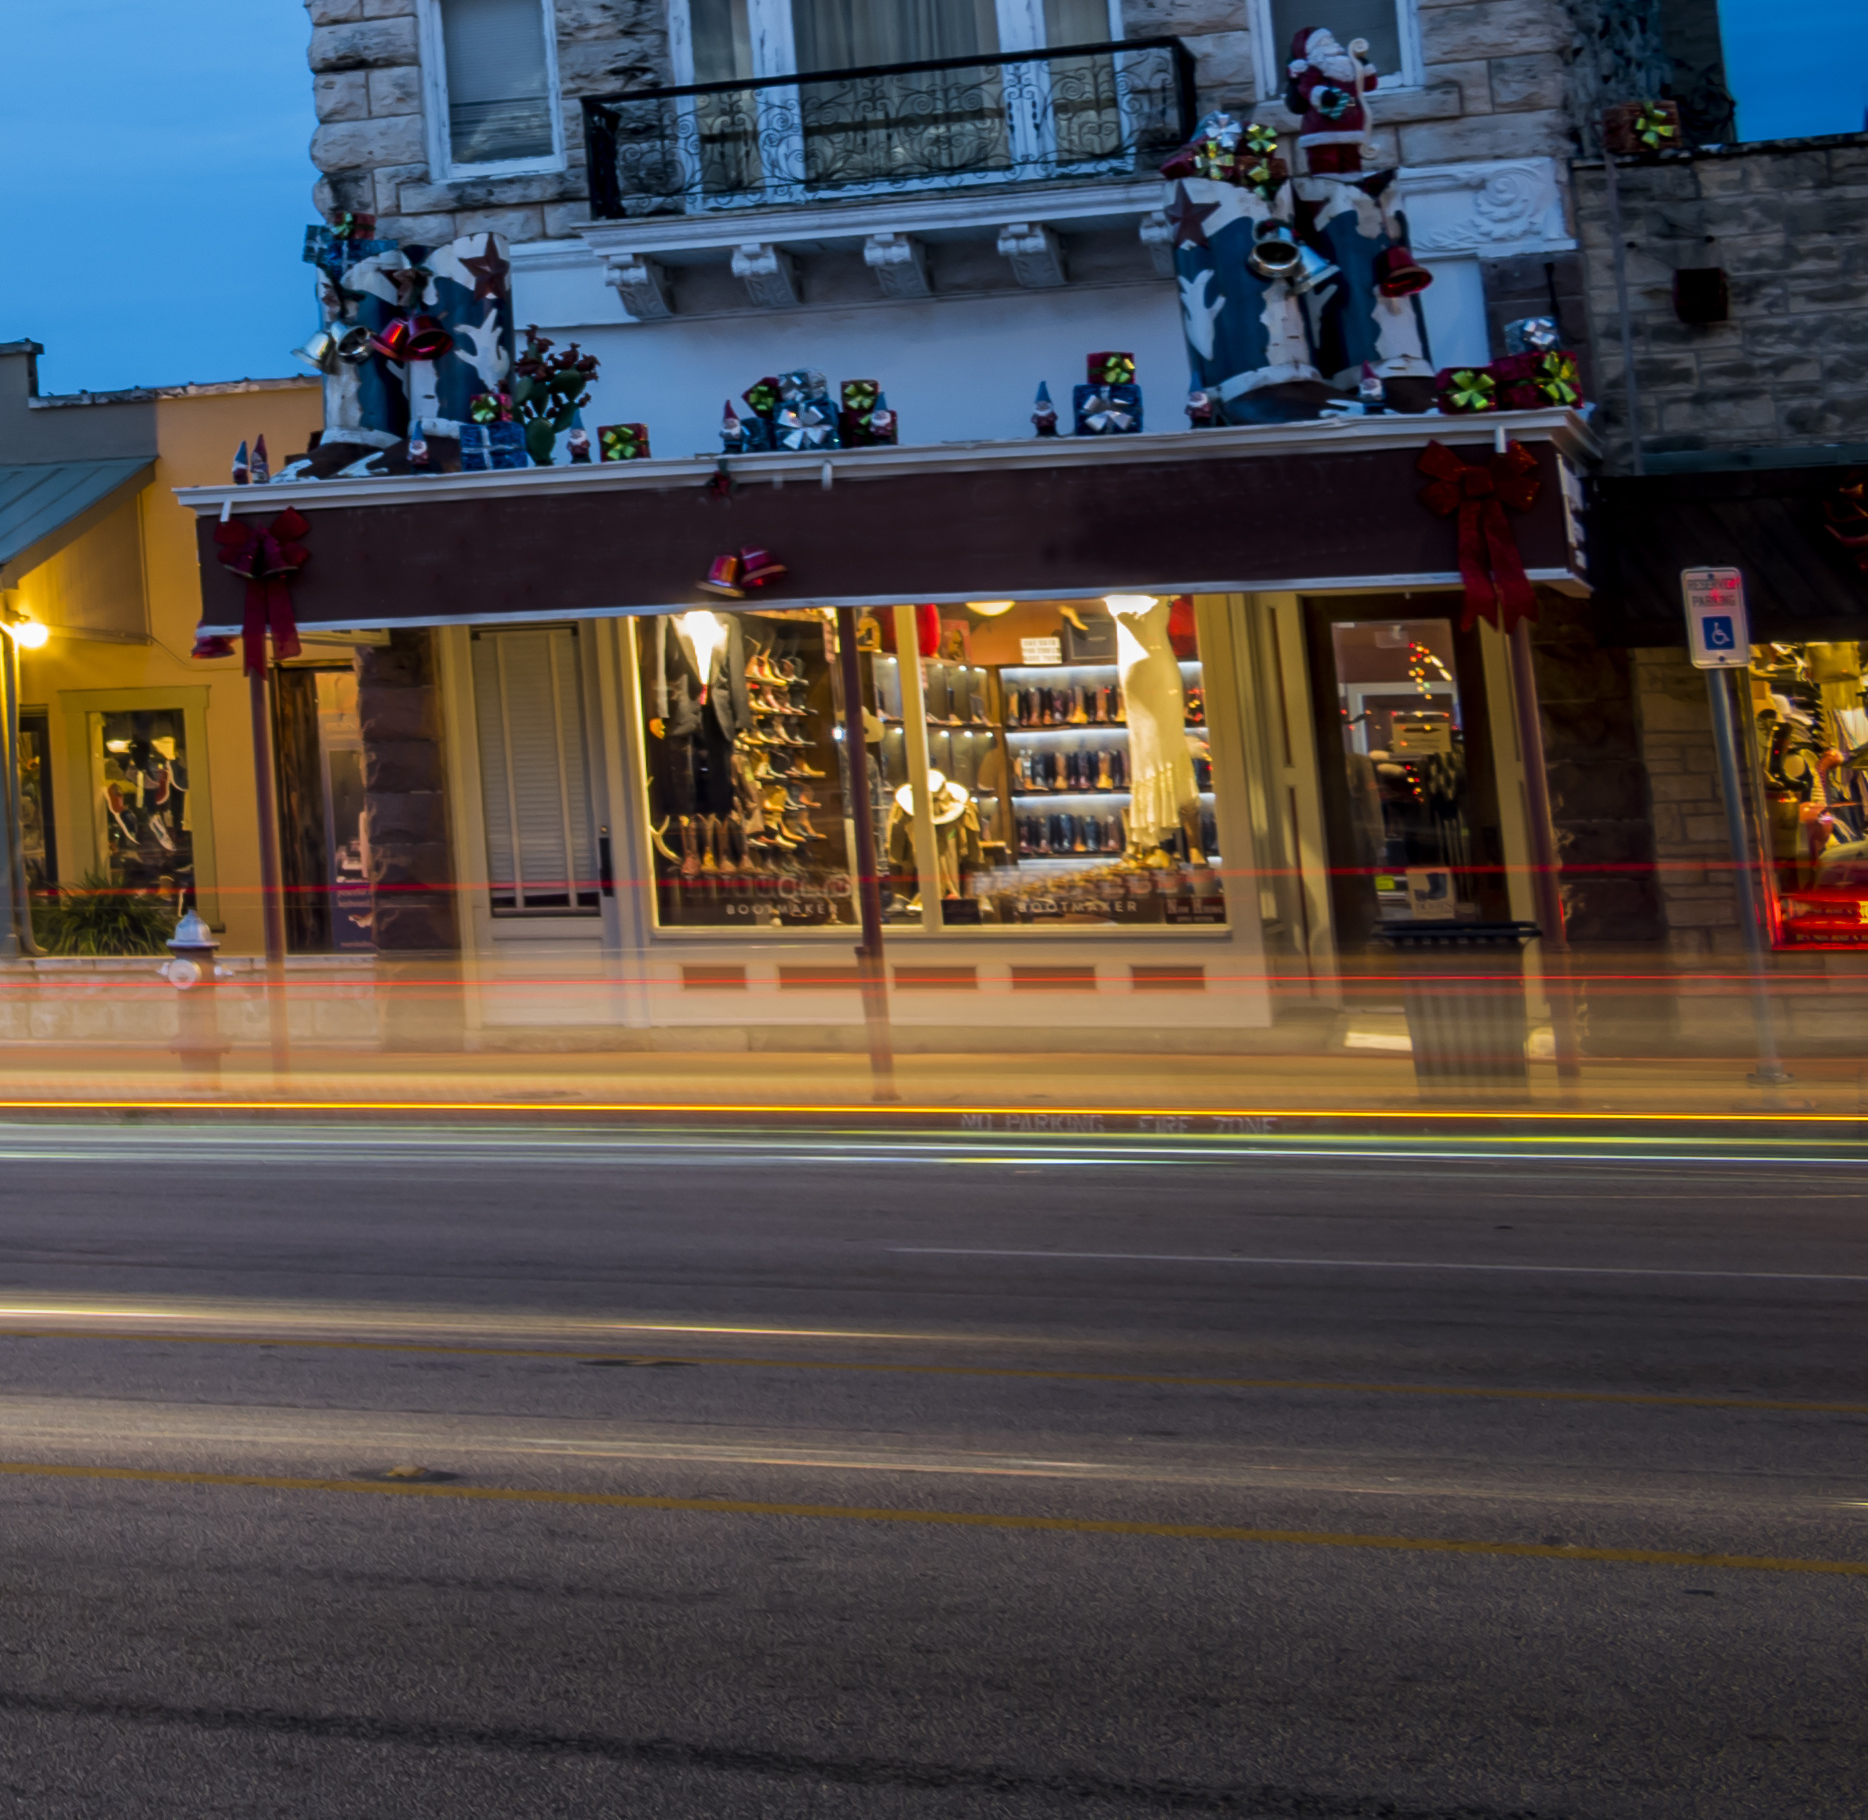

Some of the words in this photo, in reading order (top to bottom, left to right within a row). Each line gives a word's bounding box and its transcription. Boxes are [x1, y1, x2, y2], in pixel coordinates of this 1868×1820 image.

[1687, 578, 1738, 590] RESERVED
[1691, 595, 1737, 607] PARKING
[726, 903, 838, 915] BOOTMAKER
[1017, 901, 1137, 913] BOOTMAKER
[1005, 1113, 1106, 1133] PARKING
